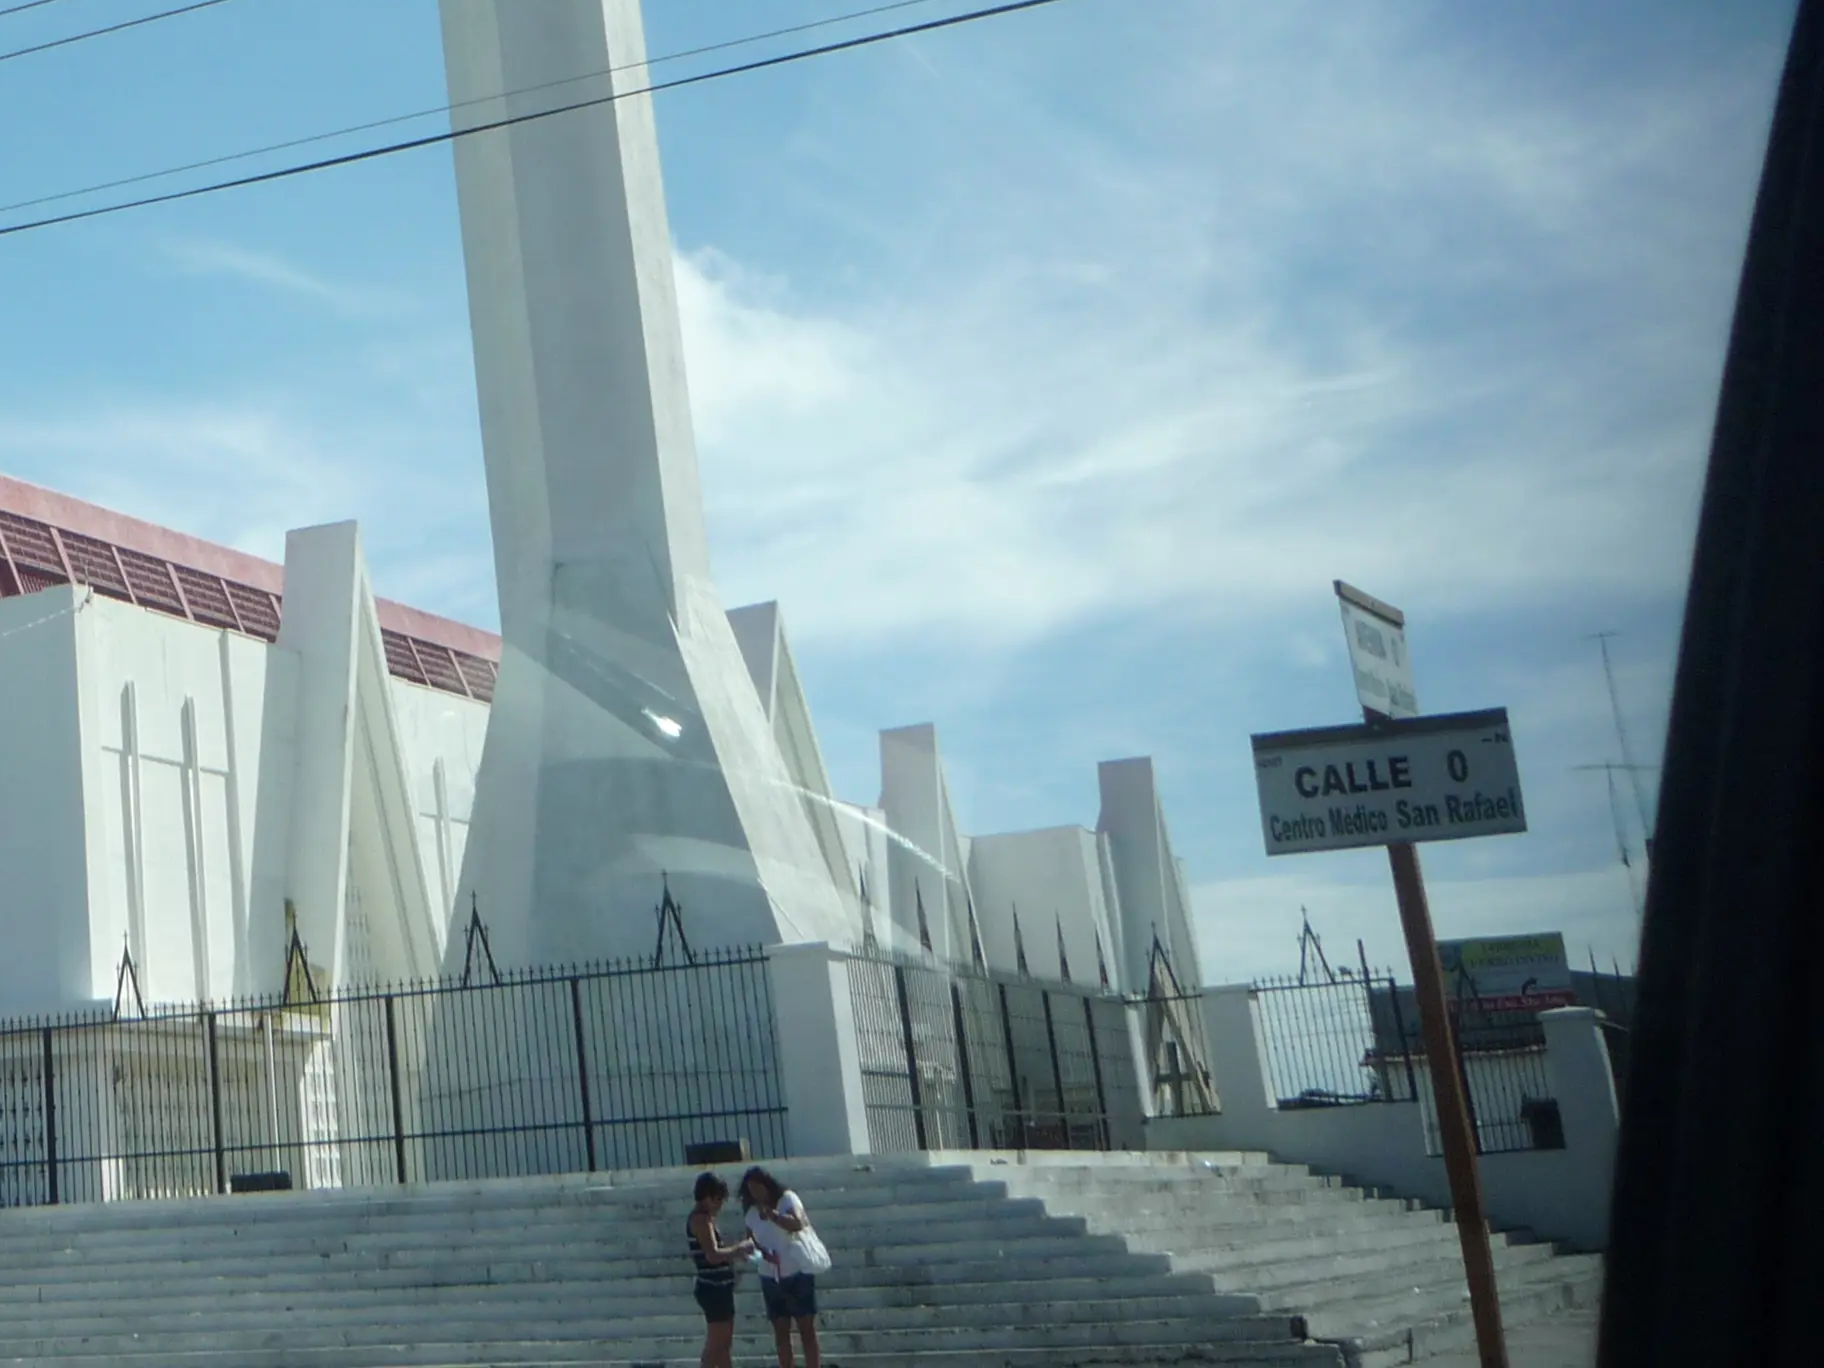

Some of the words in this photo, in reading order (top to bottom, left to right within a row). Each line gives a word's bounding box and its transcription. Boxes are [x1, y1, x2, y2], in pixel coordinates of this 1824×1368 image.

[1294, 756, 1413, 799] CALLE
[1270, 813, 1327, 843] Centro
[1397, 800, 1440, 828] San
[1446, 788, 1518, 823] Rafael
